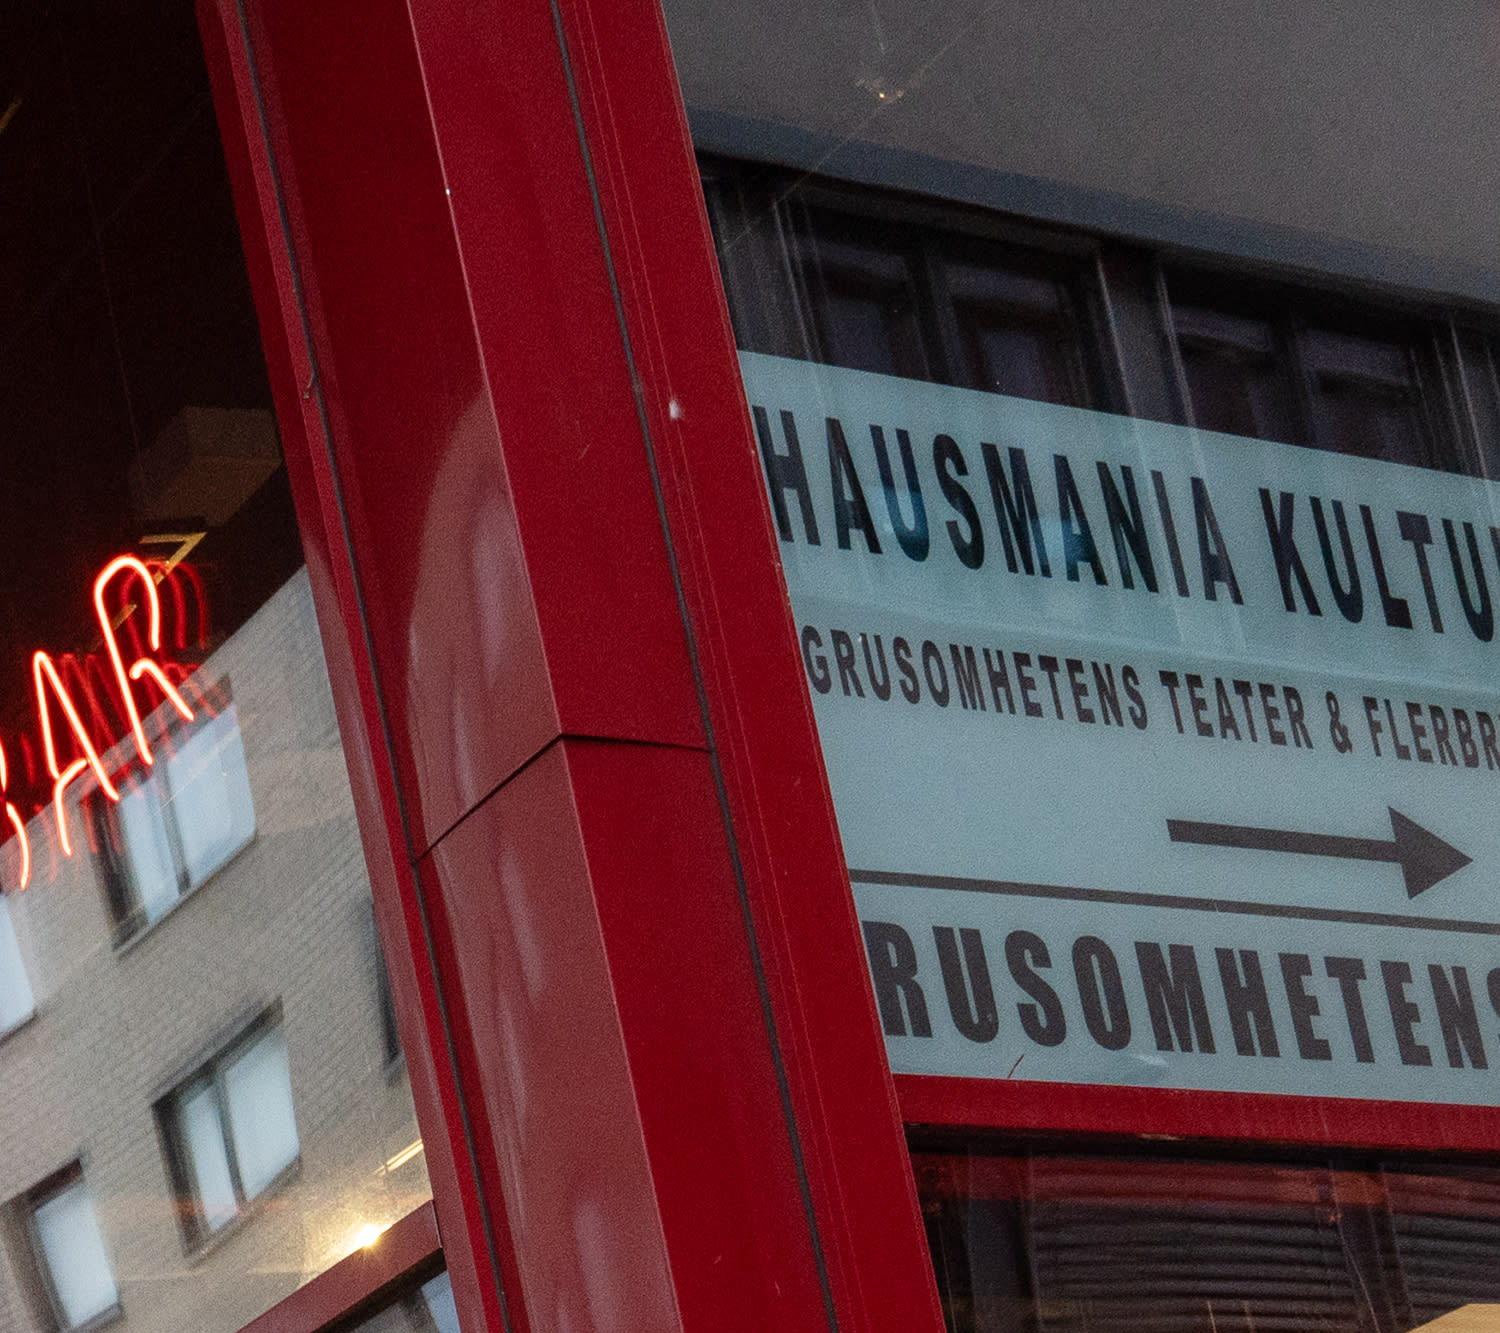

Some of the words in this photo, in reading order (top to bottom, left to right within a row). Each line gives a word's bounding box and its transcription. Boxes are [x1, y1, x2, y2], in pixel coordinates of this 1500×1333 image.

[751, 405, 1243, 606] HAUSMANIA
[803, 624, 1149, 731] GRUSOMHETENS
[1160, 670, 1314, 751] TEATER
[1328, 694, 1356, 753] &
